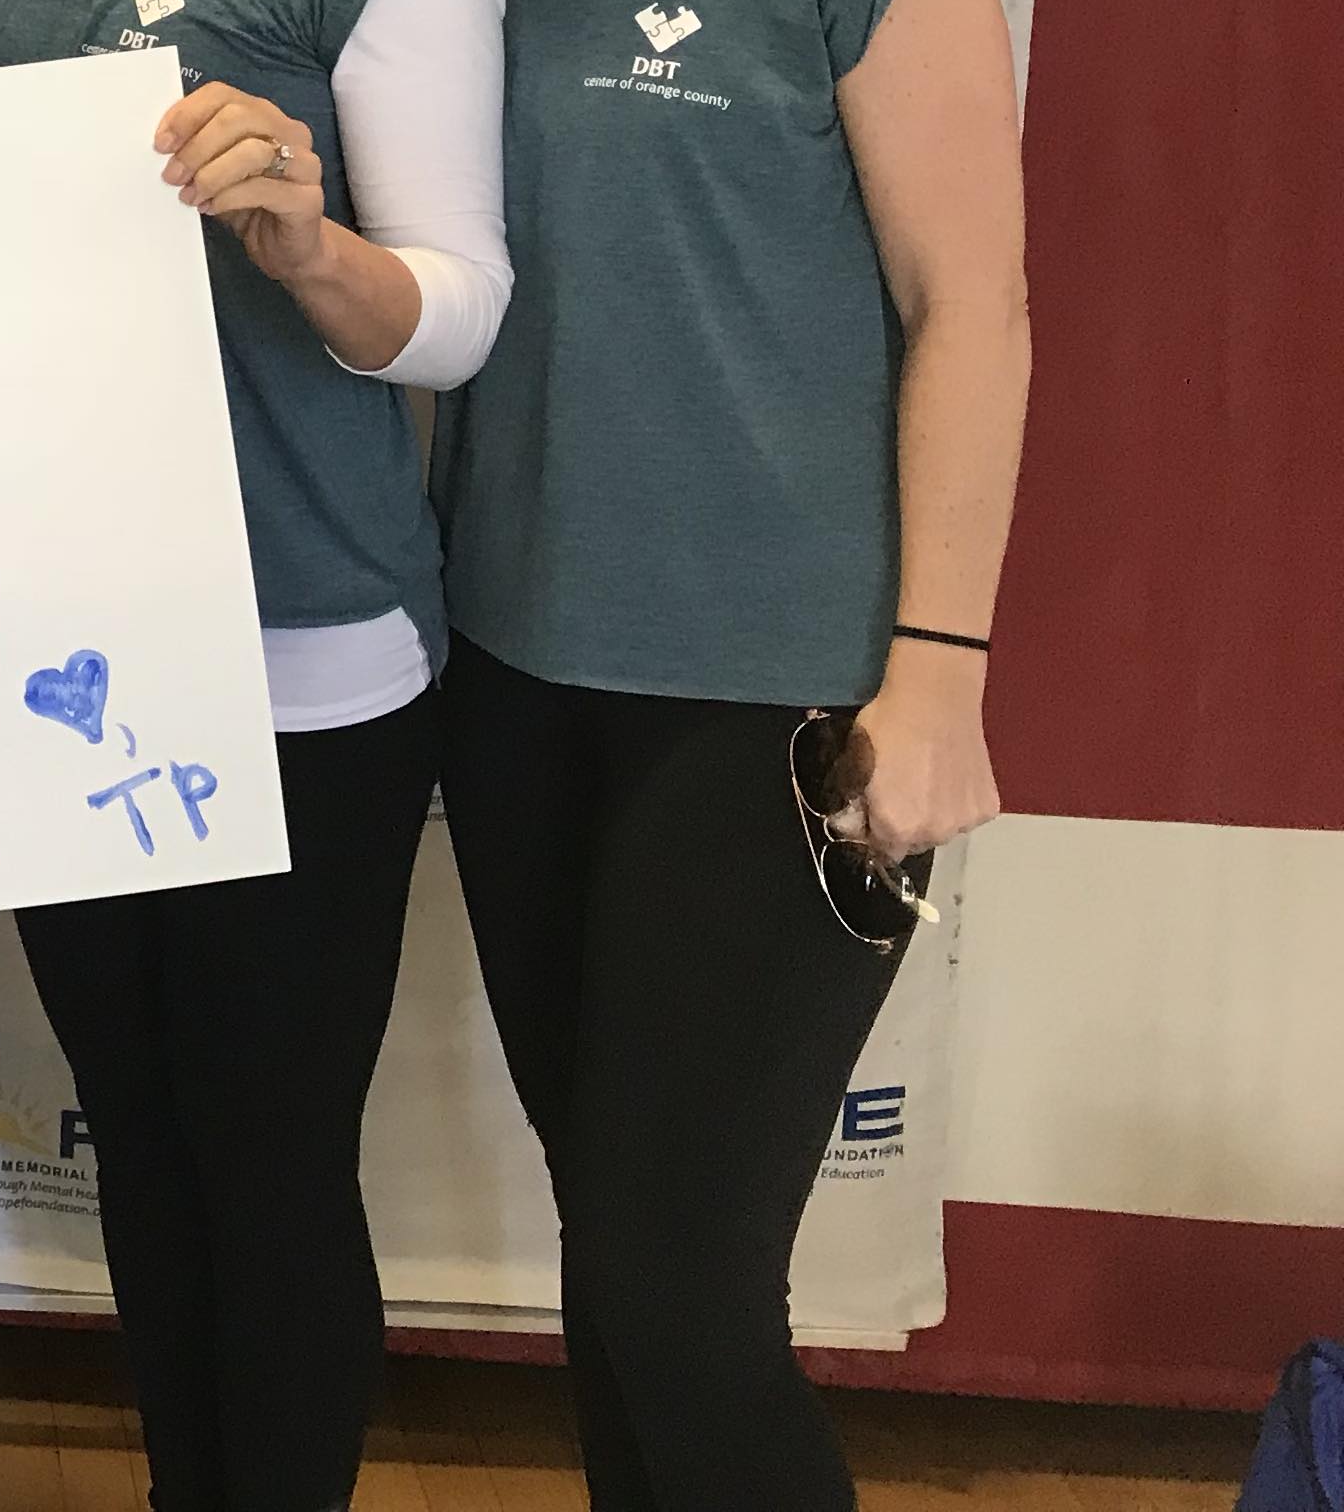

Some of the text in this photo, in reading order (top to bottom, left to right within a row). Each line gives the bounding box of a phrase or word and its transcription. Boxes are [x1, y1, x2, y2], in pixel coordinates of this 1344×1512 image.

[119, 29, 159, 49] DBT
[632, 56, 681, 80] DBT
[584, 76, 732, 111] center of orange county
[88, 760, 219, 858] TP
[1, 1160, 88, 1181] MEMORIAL
[821, 1167, 885, 1180] Education
